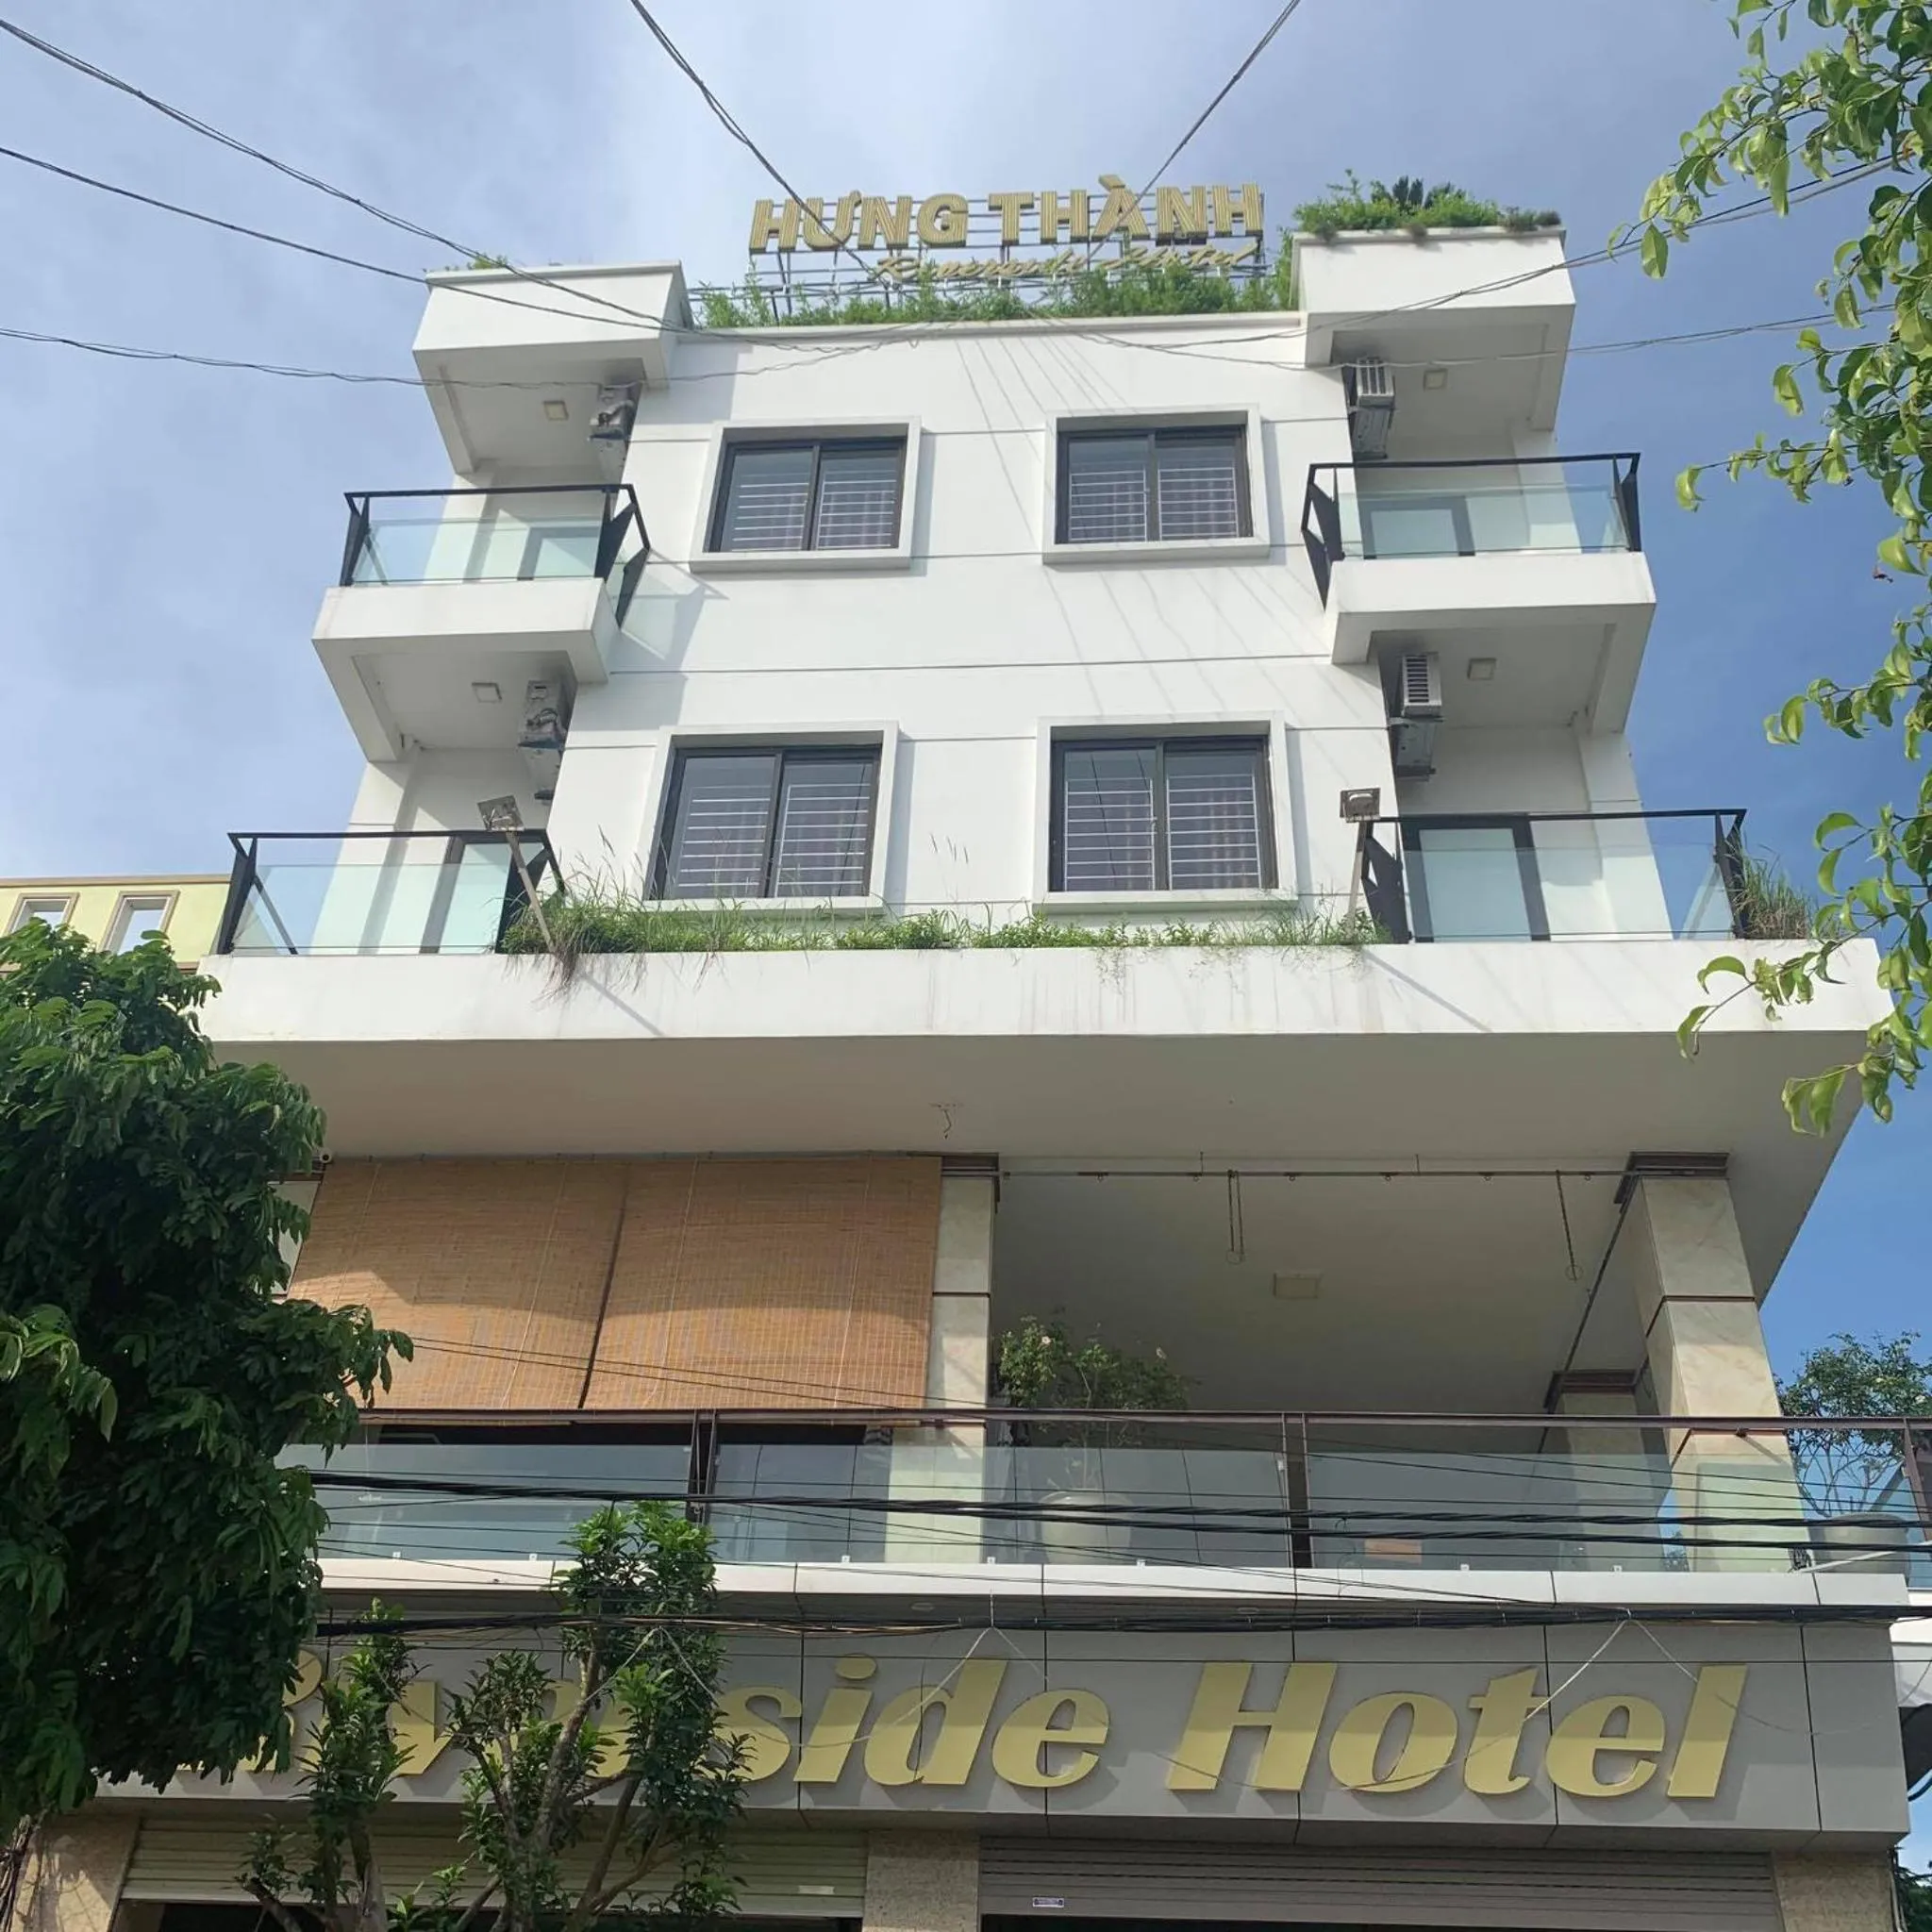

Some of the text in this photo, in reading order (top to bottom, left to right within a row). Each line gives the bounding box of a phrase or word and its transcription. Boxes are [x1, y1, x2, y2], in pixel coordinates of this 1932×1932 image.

[748, 174, 1264, 253] HƯNG THÀNH
[1166, 1660, 1747, 1798] Hotel
